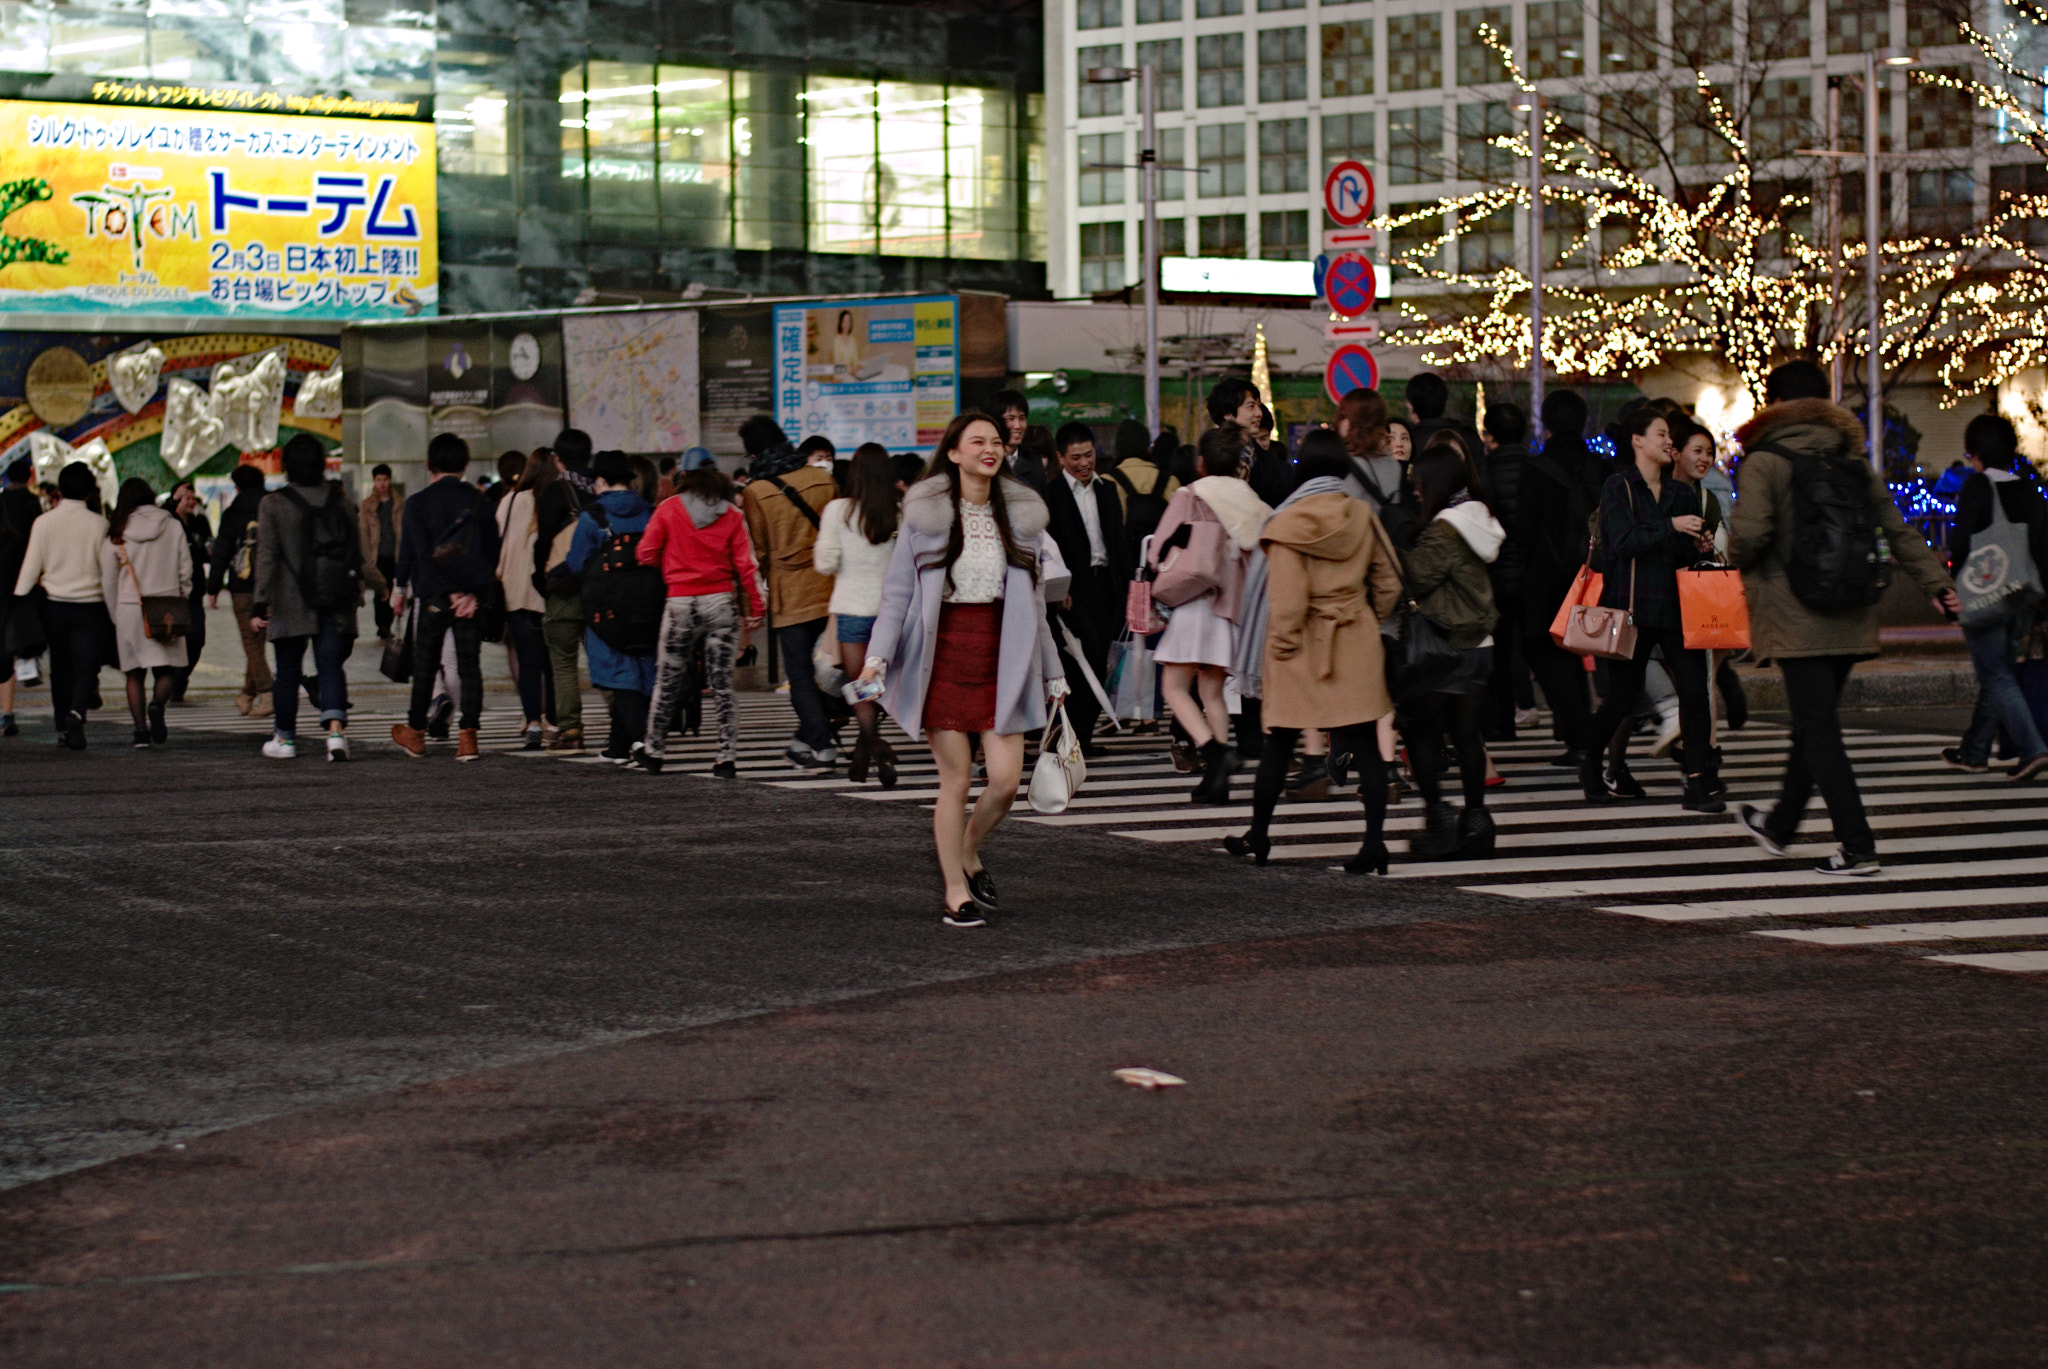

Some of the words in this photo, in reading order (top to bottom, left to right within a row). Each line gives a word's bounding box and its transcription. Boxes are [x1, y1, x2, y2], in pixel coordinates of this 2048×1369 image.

[73, 185, 197, 267] TOTEM
[211, 172, 418, 236] トーテム
[212, 243, 280, 271] 2月3日
[287, 245, 418, 276] 日本初上陸!!
[212, 277, 388, 304] お台場ビッグトップ
